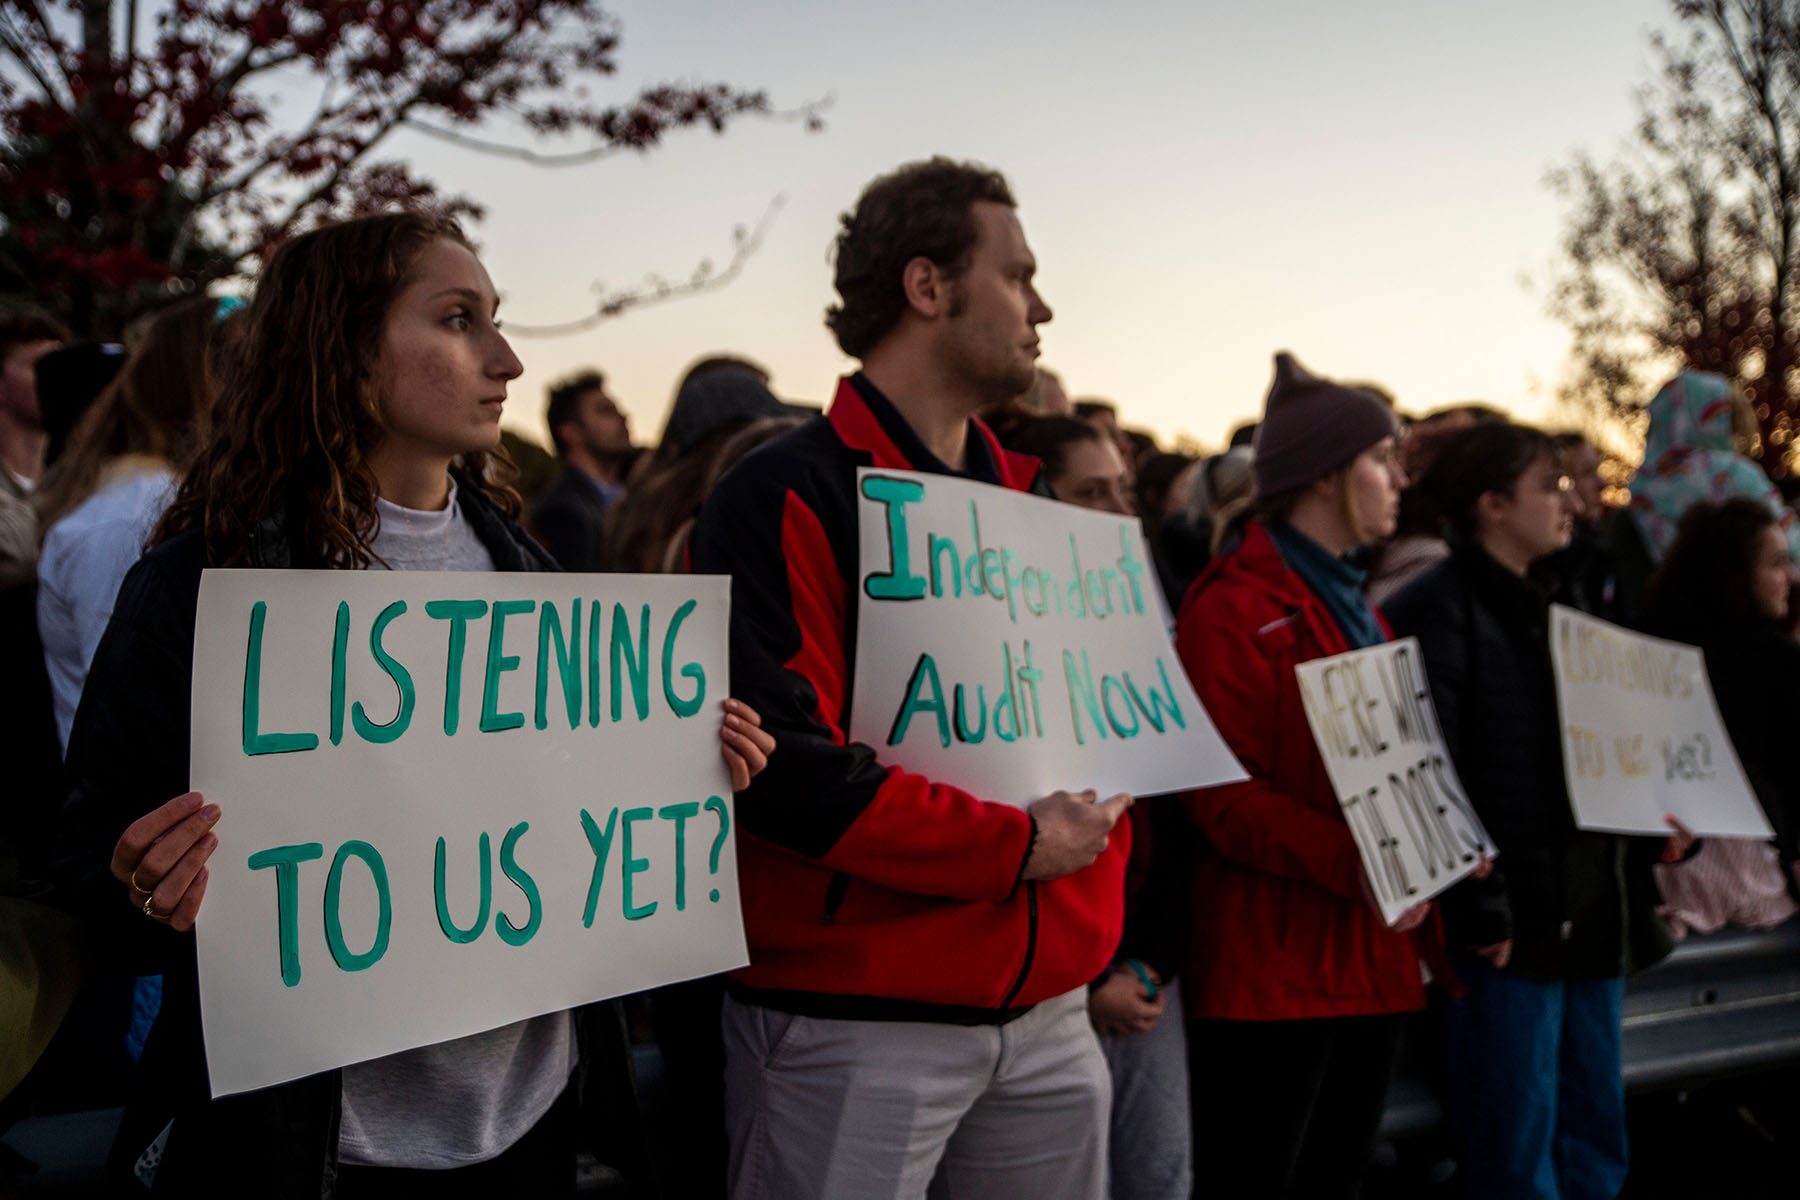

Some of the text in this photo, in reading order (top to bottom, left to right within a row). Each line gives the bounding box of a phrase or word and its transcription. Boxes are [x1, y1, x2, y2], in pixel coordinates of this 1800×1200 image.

[861, 473, 1145, 623] Independent
[243, 597, 706, 757] LISTENING
[886, 639, 1043, 749] Audit
[248, 795, 730, 987] TO US YET?
